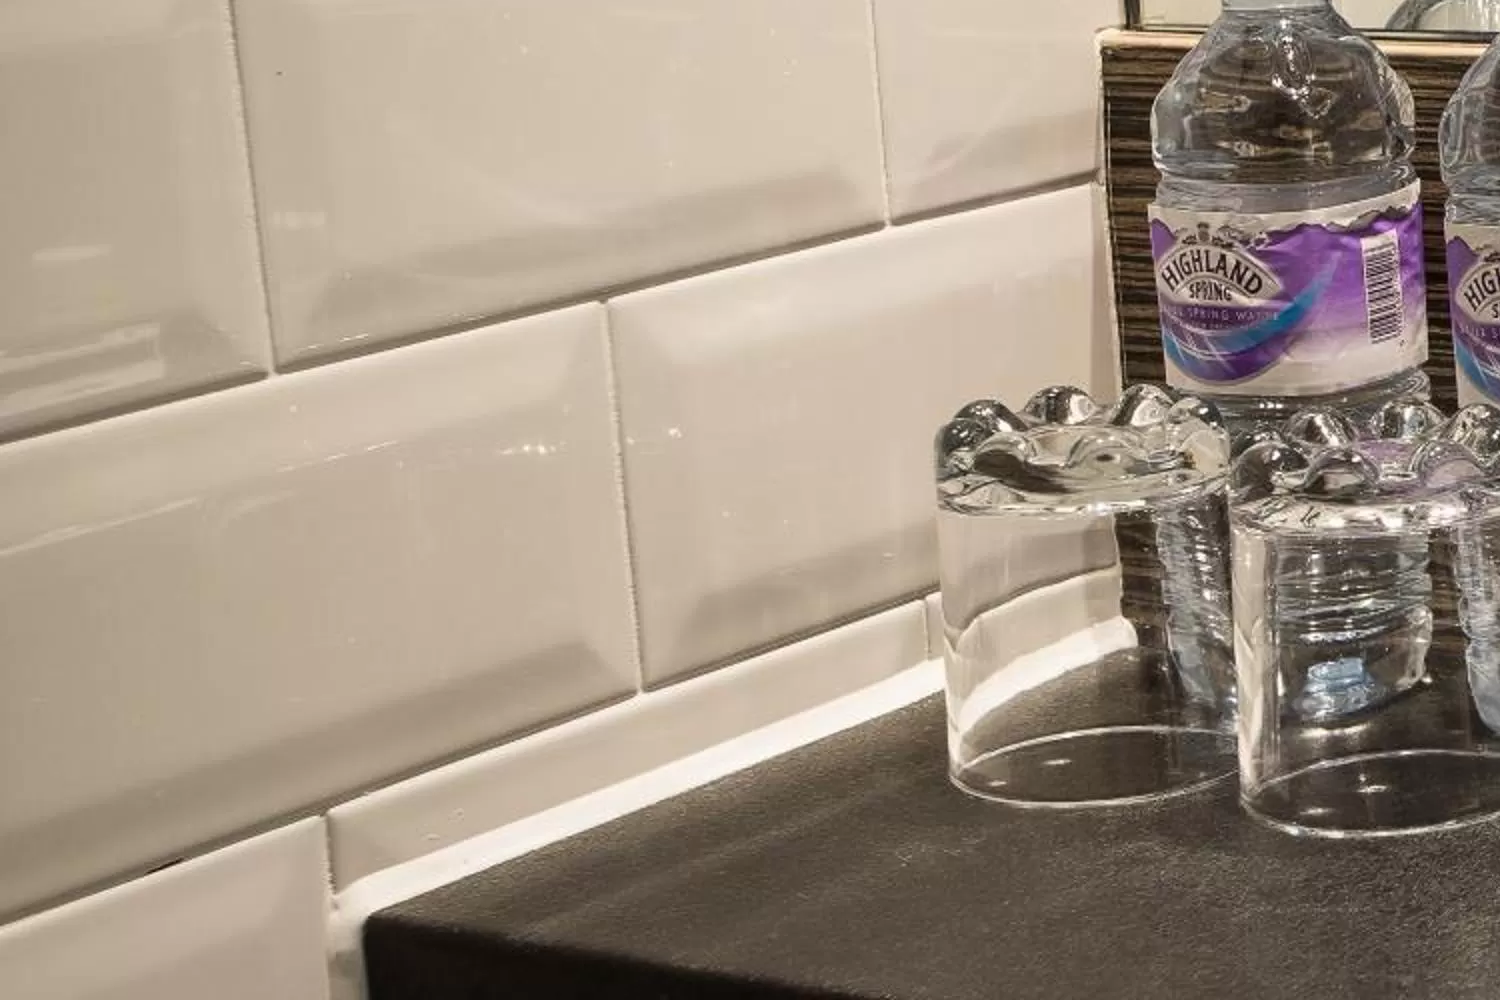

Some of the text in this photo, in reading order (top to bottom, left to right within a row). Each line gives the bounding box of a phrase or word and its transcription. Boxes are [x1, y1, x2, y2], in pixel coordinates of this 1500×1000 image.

[1160, 248, 1263, 296] HIGHLAND
[1188, 280, 1232, 301] SPRING
[1186, 307, 1230, 321] SPRING
